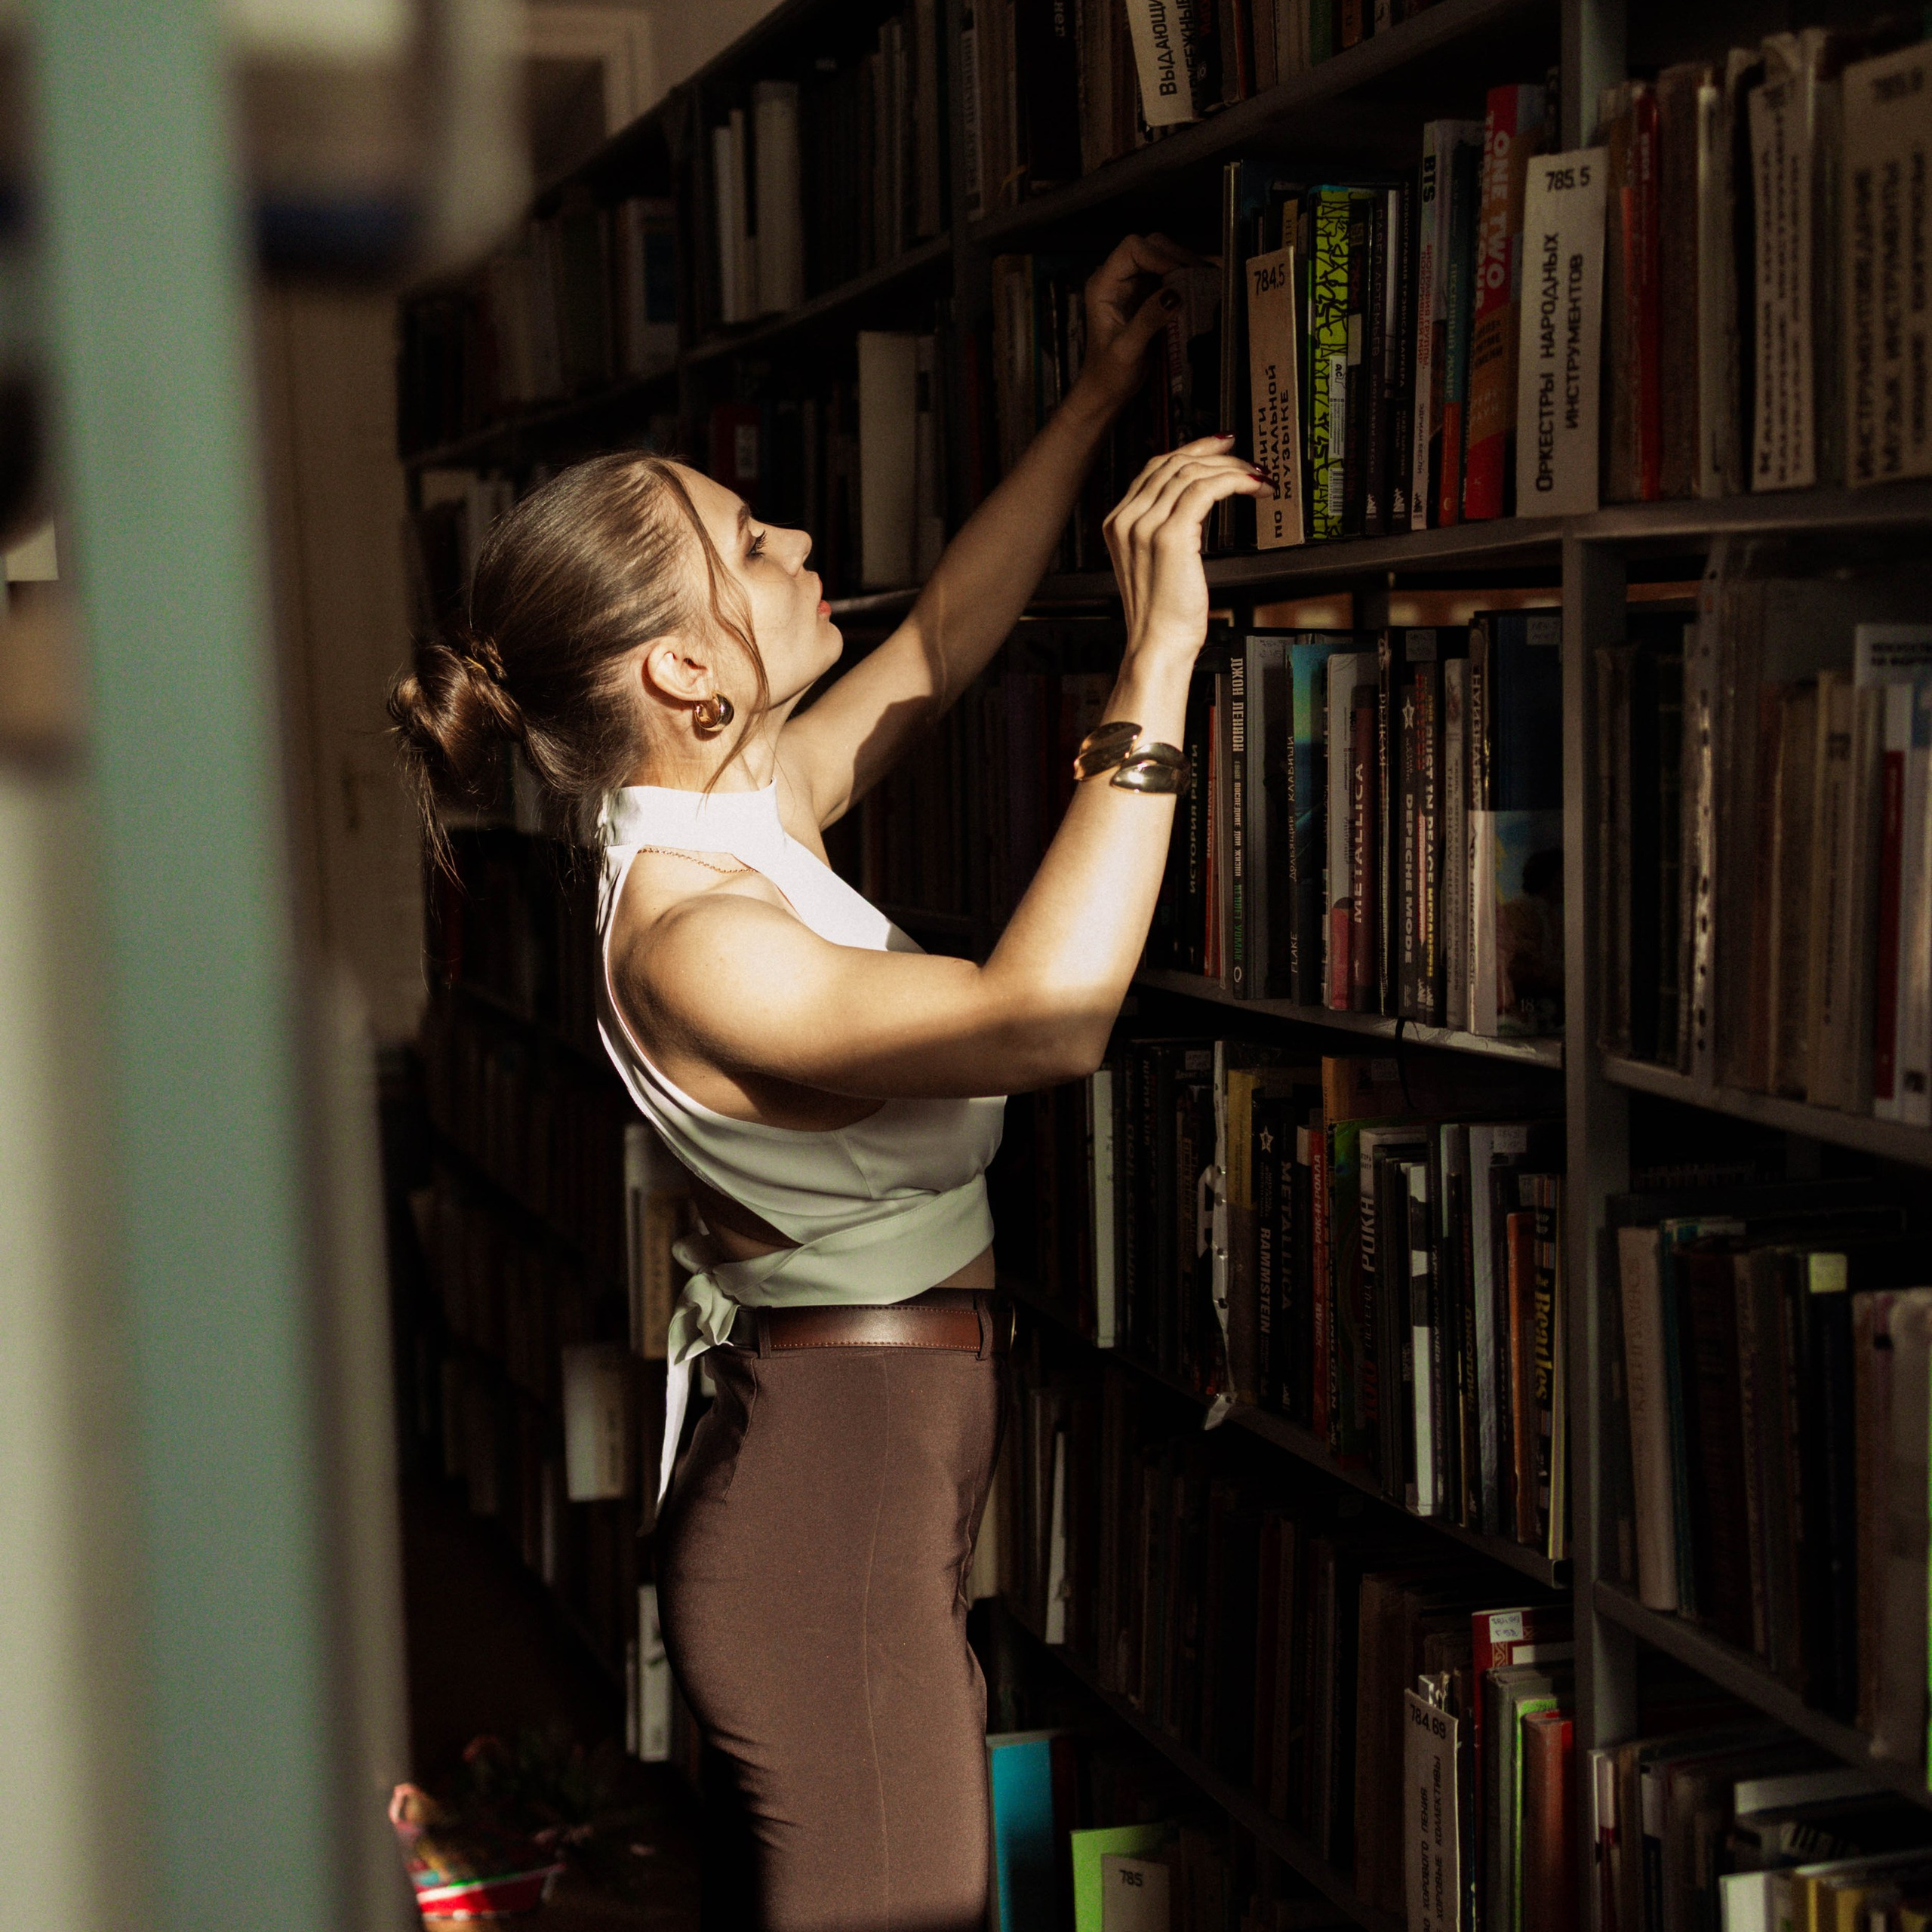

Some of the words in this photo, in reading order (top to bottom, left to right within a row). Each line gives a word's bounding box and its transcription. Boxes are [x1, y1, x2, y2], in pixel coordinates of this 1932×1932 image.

[1423, 155, 1436, 203] BTS
[1490, 130, 1509, 201] ONE
[1375, 209, 1383, 266] ПАВЕЛ
[1401, 181, 1411, 281] АВТОБИОГРАФИЯ
[1486, 211, 1508, 290] TWO
[1254, 263, 1285, 296] 784.5
[1400, 285, 1408, 335] ТРЭВИСА
[1423, 245, 1432, 315] БИОГРАФИЯ
[1448, 263, 1458, 351] ПЕСЕННЫЙ
[1540, 232, 1560, 359] НАРОДНЫХ
[1371, 272, 1382, 358] АРТЕМЬЕВ
[1565, 254, 1584, 430] ИНСТРУМЕНТОВ
[1398, 338, 1407, 389] БАРКЕРА
[1447, 354, 1457, 400] ЖАНР
[1258, 408, 1269, 468] НИГИ
[1281, 389, 1292, 500] МУЗЫКЕ
[1274, 510, 1283, 538] ПО
[1231, 657, 1244, 697] ДЖОН
[1232, 701, 1244, 753] ЛЕННОН
[1189, 743, 1199, 801] РЕГГИ
[1287, 735, 1295, 802] КЛАВИШИ
[1425, 783, 1434, 810] IN
[1233, 782, 1241, 827] ПОСЛЕДНИЕ
[1188, 804, 1198, 895] ИСТОРИЯ
[1233, 848, 1241, 876] ЖИЗНИ
[1287, 815, 1297, 881] ДОЛБЯЩИЙ
[1354, 762, 1363, 924] METALLICA
[1404, 792, 1414, 892] DEPECHE
[1445, 868, 1454, 915] MUST
[1290, 932, 1298, 974] FLAKE
[1404, 895, 1414, 964] MODE
[1445, 918, 1453, 949] GO
[1445, 956, 1453, 983] ON
[1313, 1153, 1322, 1244] РОК-Н-РОЛЛА
[1281, 1160, 1293, 1312] METALLICA
[1260, 1226, 1272, 1336] RAMMSTEIN
[1464, 1305, 1475, 1412] ДЖОПЛИН
[1534, 1290, 1553, 1401] Beatles
[1361, 1358, 1378, 1423] 100
[1409, 1703, 1447, 1740] 784.69
[1420, 1787, 1430, 1833] ПЕНИЯ
[1433, 1755, 1443, 1847] КОЛЛЕКТИВЫ
[1119, 1869, 1143, 1887] 785
[1420, 1841, 1432, 1911] ХОРОВОГО
[1434, 1855, 1444, 1921] ХОРОВЫЕ
